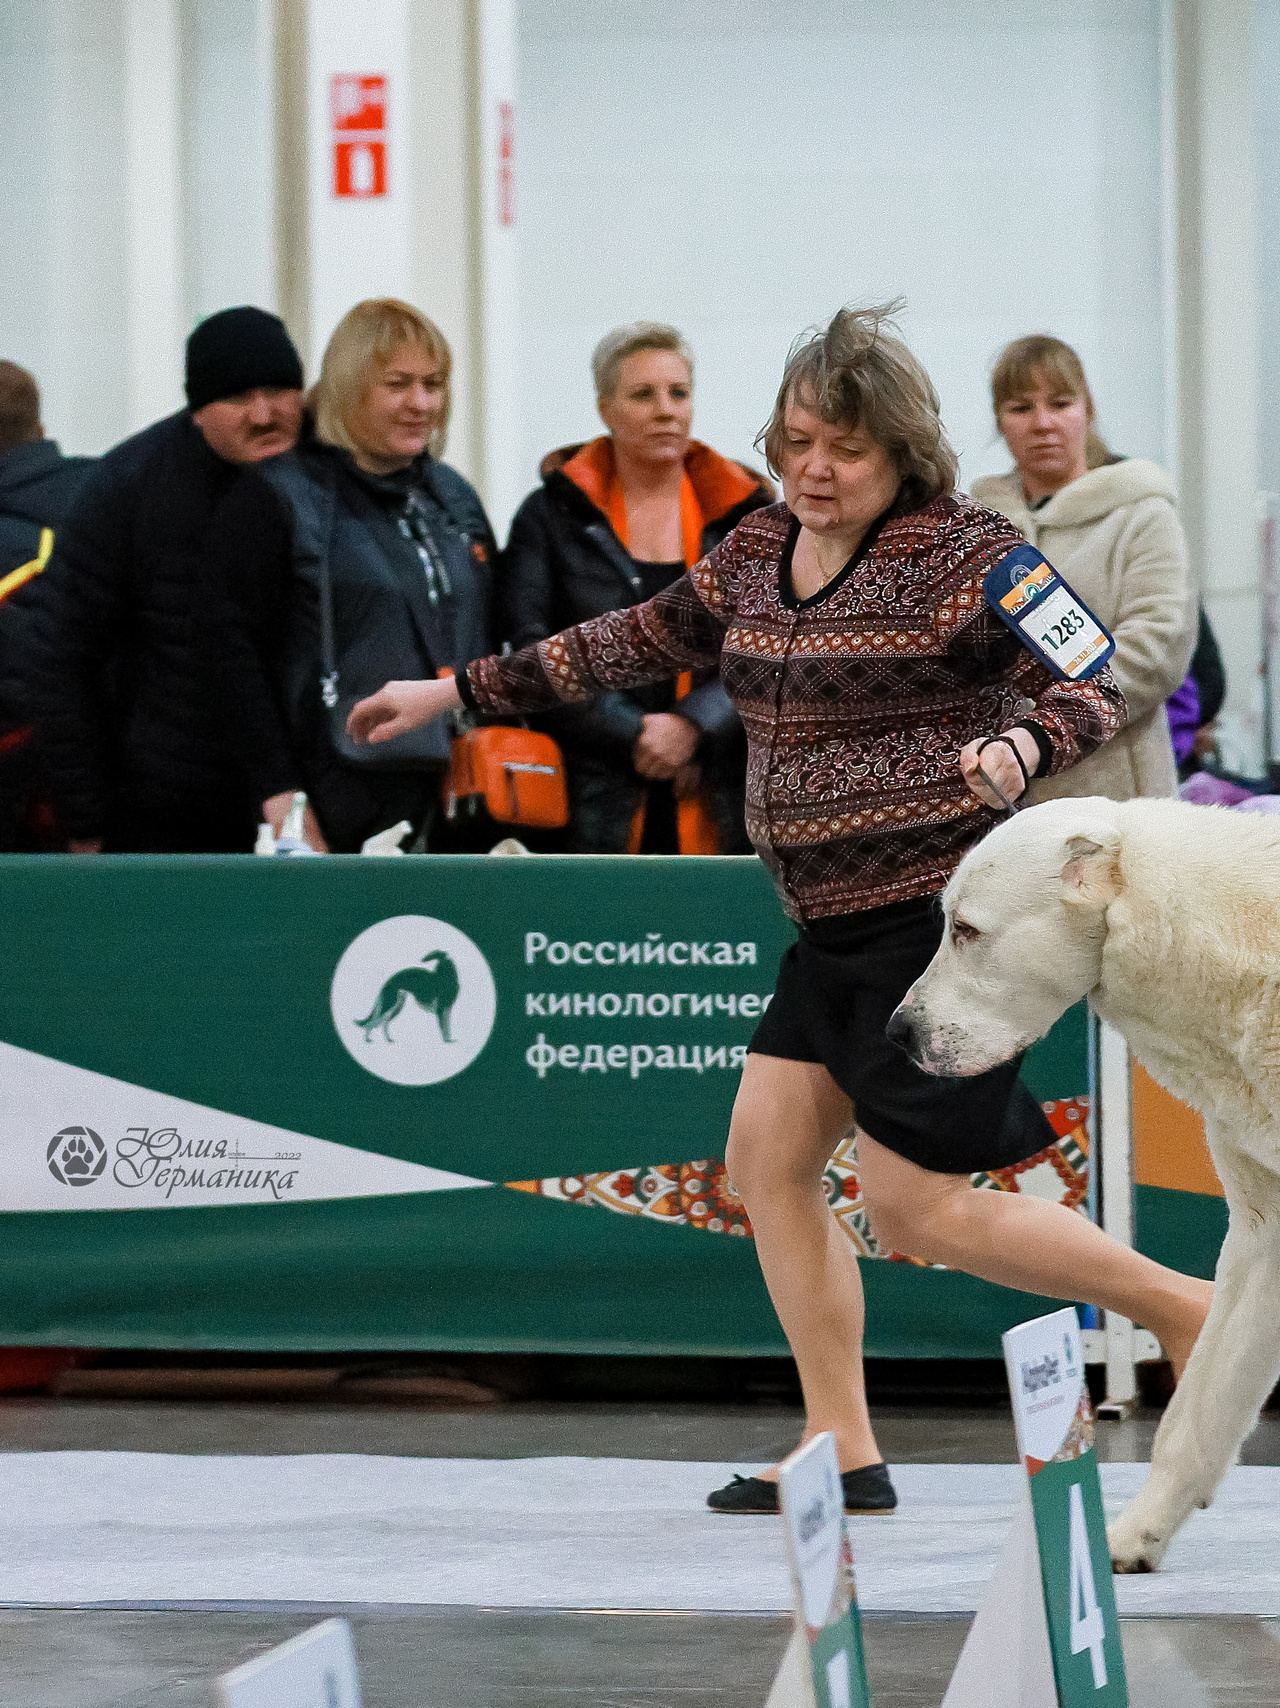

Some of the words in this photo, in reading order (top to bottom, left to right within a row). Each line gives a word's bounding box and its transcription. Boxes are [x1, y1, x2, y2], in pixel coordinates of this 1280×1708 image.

[1041, 609, 1085, 650] 1283
[525, 932, 757, 966] Российская
[526, 1032, 749, 1078] федерация
[1069, 1482, 1108, 1690] 4
